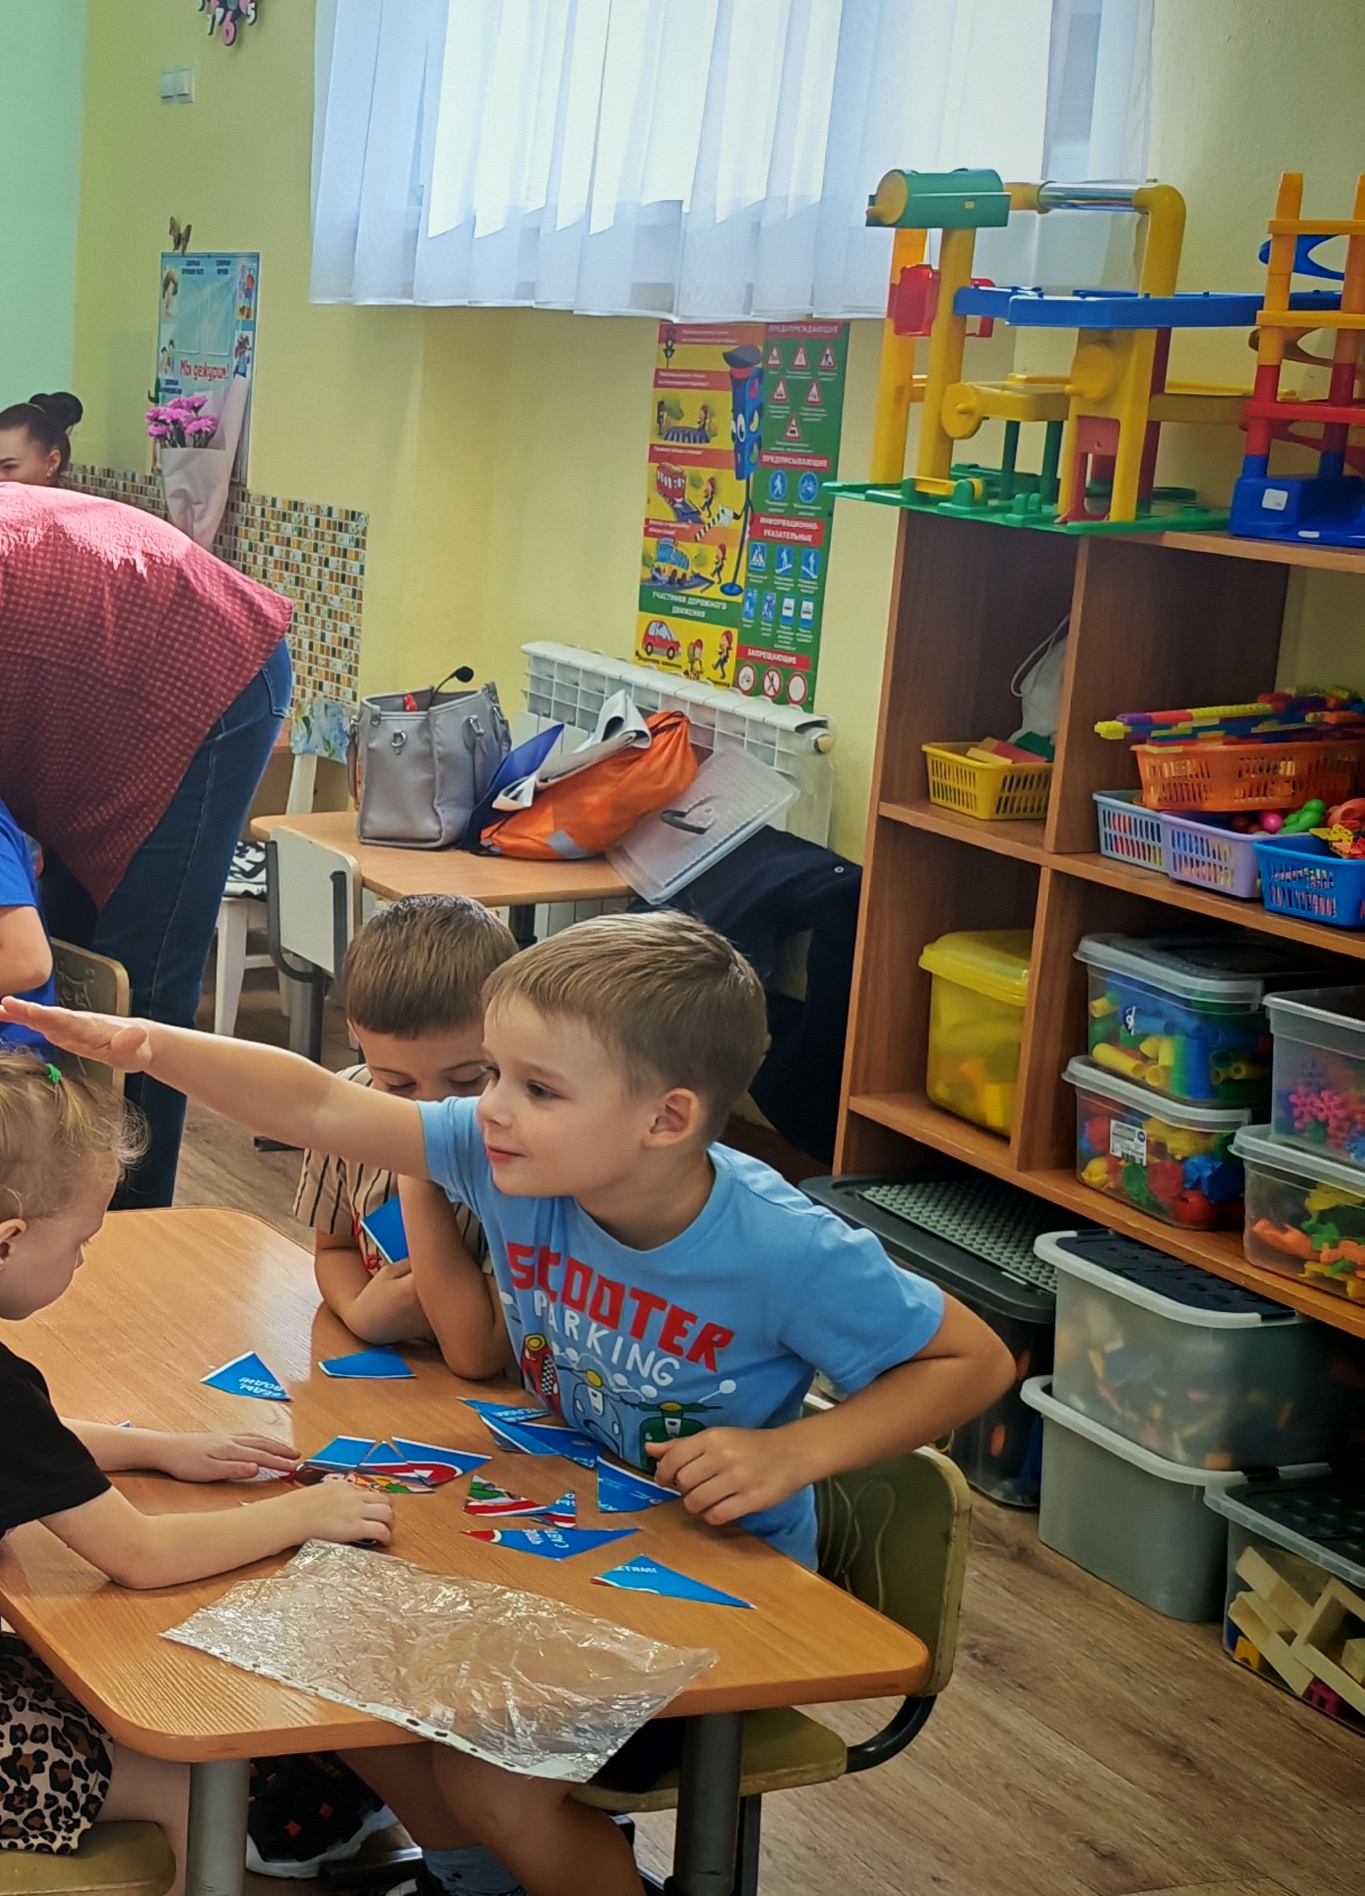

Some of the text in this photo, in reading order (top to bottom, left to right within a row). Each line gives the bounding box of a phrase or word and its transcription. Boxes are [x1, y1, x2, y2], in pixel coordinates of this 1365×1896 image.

[222, 10, 237, 46] 6
[506, 1241, 735, 1373] SCOOTER
[533, 1289, 681, 1388] PARKING
